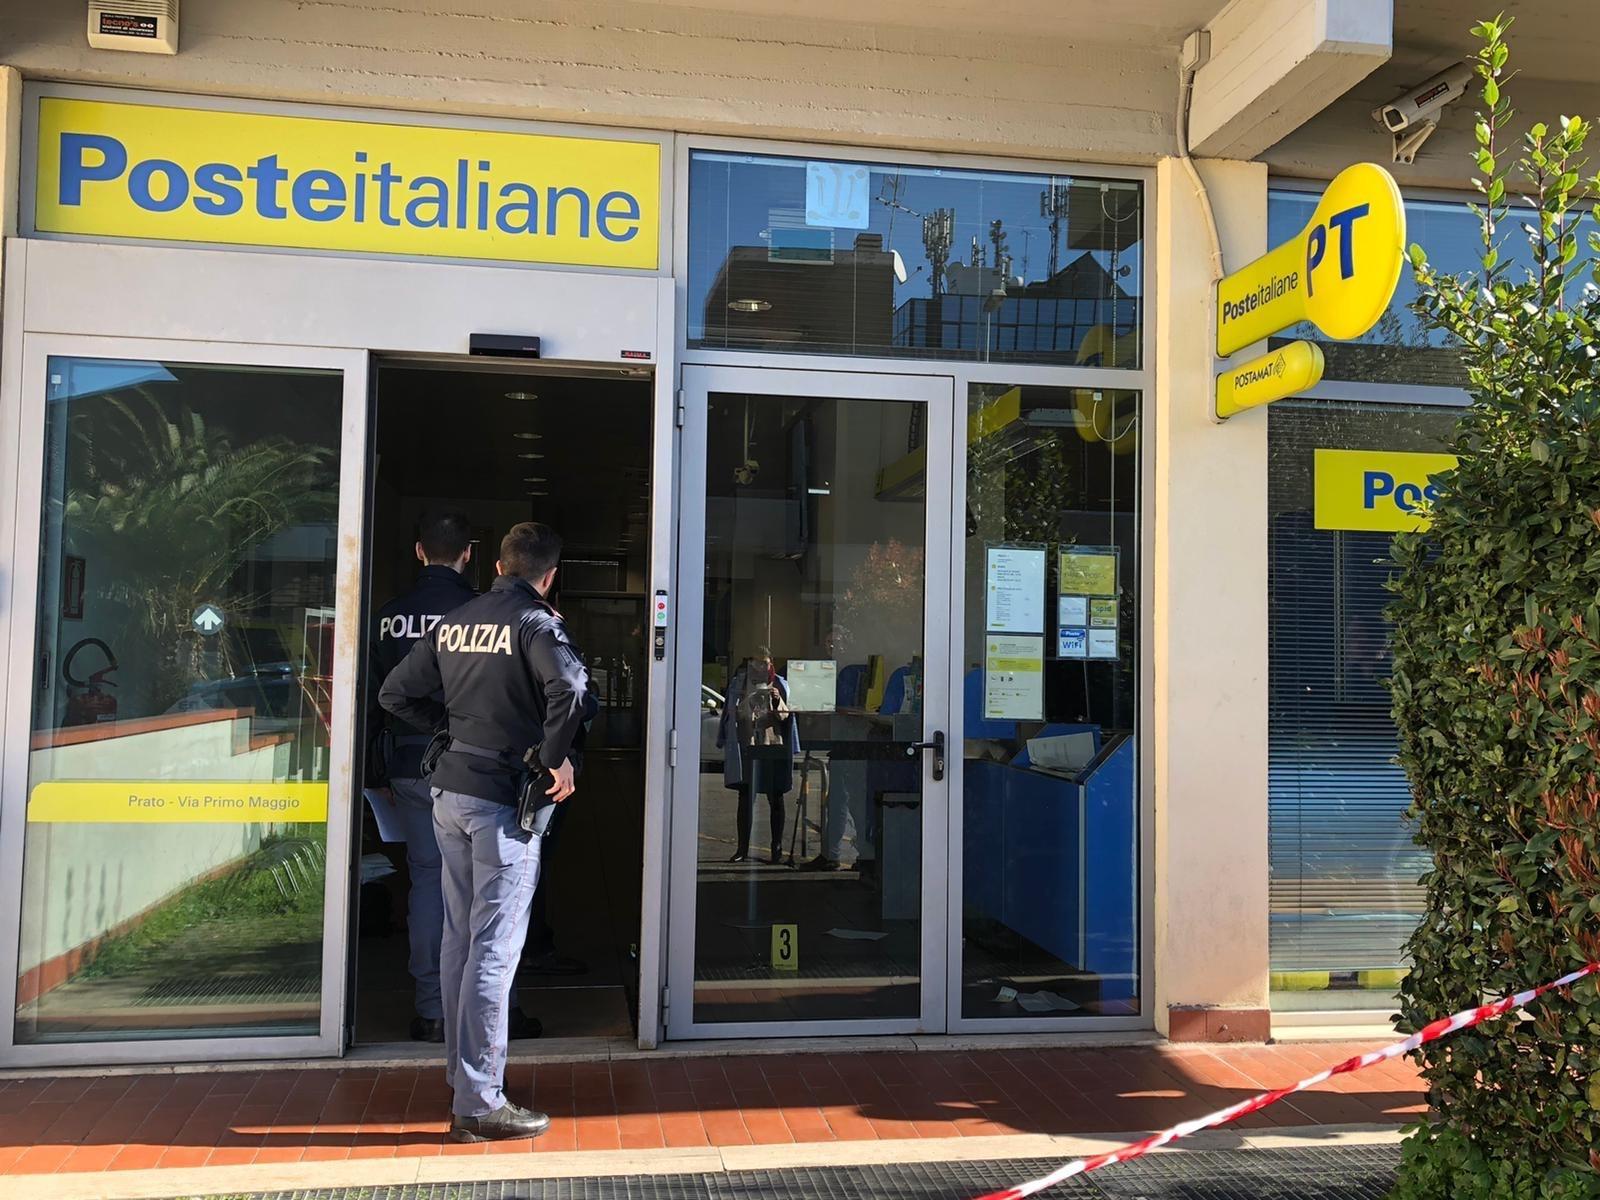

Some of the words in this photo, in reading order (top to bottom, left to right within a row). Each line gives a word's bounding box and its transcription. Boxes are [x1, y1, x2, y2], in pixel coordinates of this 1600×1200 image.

[58, 131, 640, 242] Posteitaliane
[1306, 202, 1370, 298] PT
[1222, 271, 1298, 324] Posteitaliane
[1234, 363, 1274, 390] POSTAMAT
[380, 614, 445, 640] POLIZ
[437, 623, 512, 655] POLIZIA
[128, 795, 165, 808] Prato
[177, 796, 199, 808] Via
[204, 796, 244, 808] Primo
[248, 796, 300, 811] Maggio
[780, 928, 791, 960] 3
